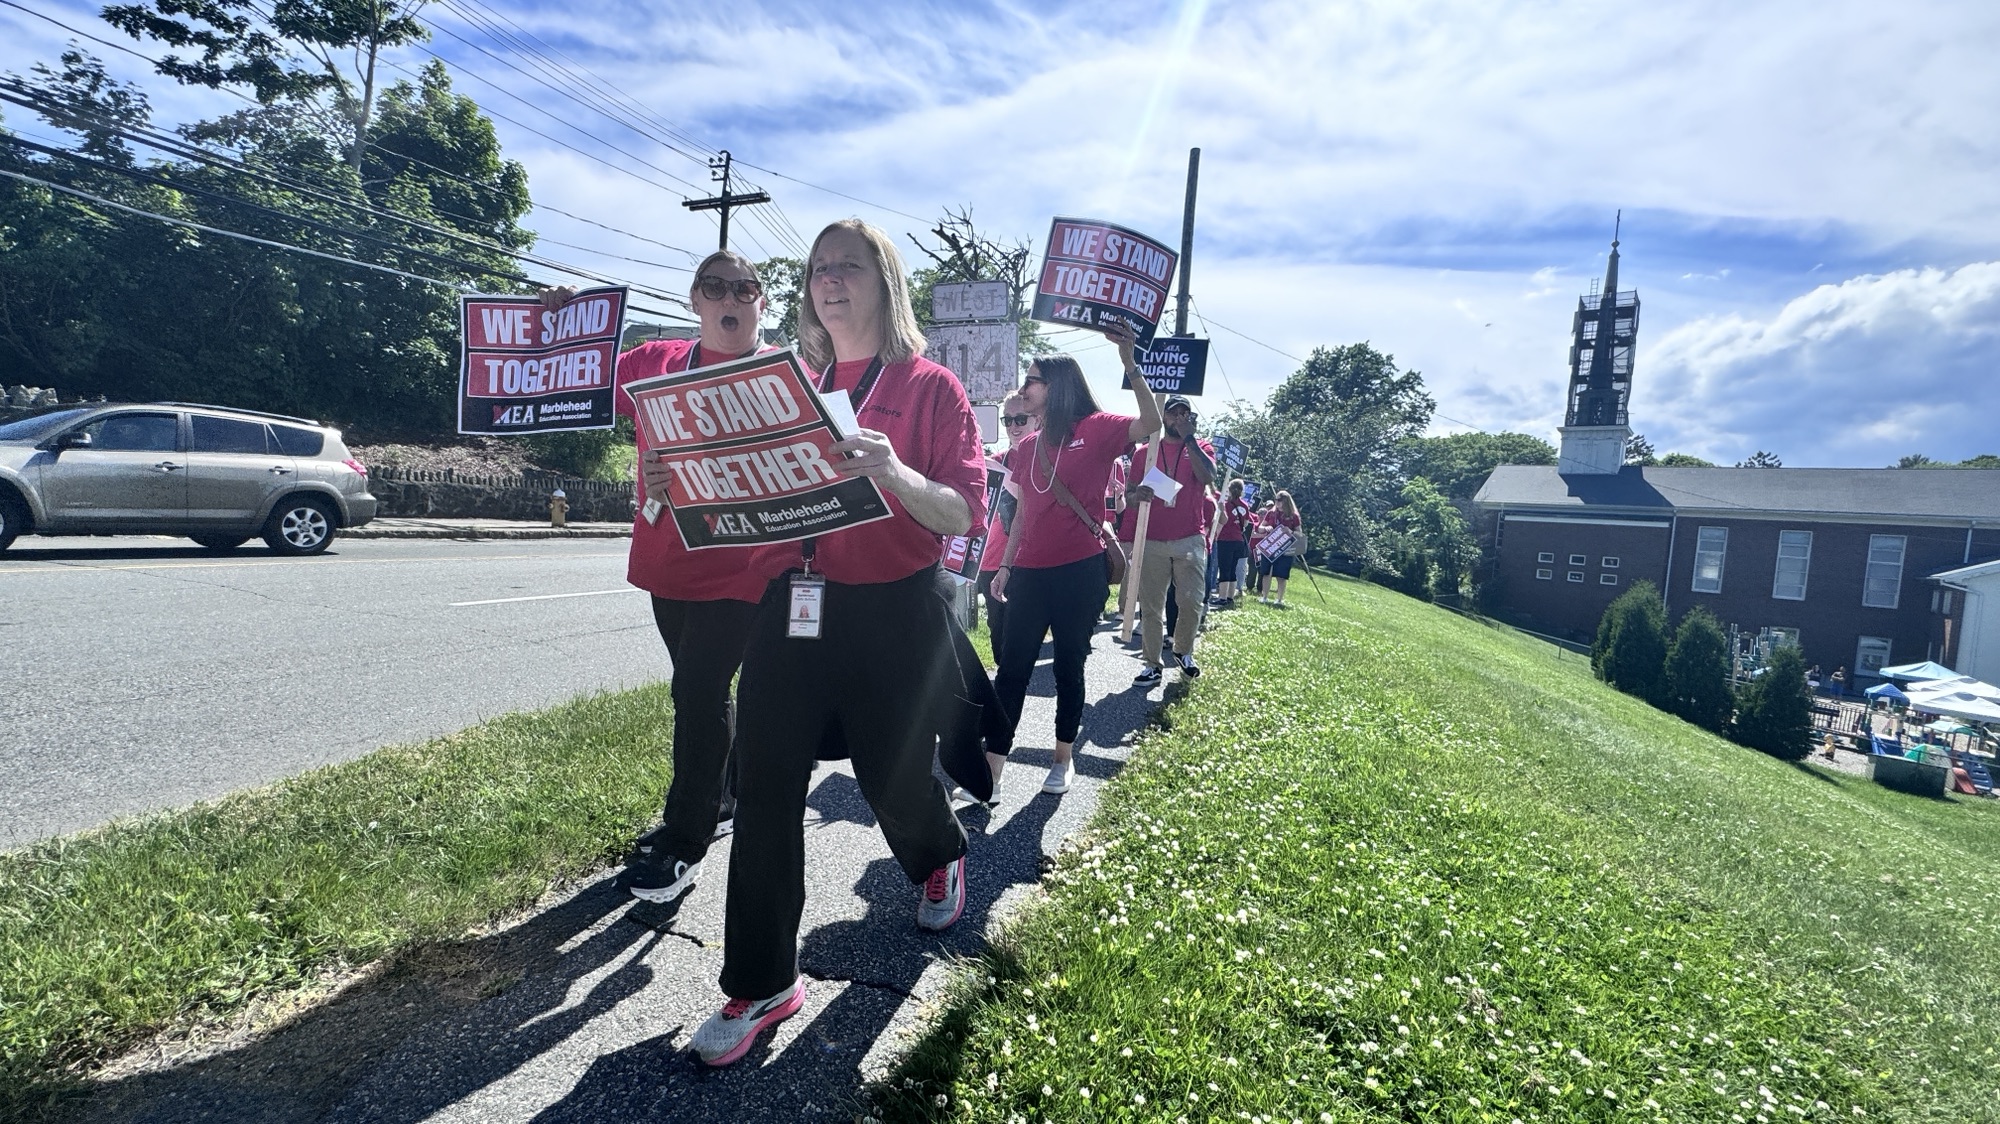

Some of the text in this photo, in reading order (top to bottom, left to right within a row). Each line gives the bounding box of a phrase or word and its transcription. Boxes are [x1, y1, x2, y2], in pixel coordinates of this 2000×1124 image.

[1062, 227, 1169, 282] WE STAND
[943, 288, 998, 313] WEST
[1053, 265, 1158, 319] TOGETHER
[481, 299, 611, 345] WE STAND
[484, 350, 601, 394] TOGETHER
[937, 341, 1004, 383] 114
[1142, 351, 1190, 364] LIVING
[1143, 365, 1186, 378] WAGE
[1146, 378, 1180, 390] NOW
[540, 399, 592, 414] Marblehead
[643, 374, 800, 443] WE STAND
[667, 441, 838, 502] TOGETHER
[757, 496, 842, 525] Marblehead
[765, 509, 848, 533] Education Association
